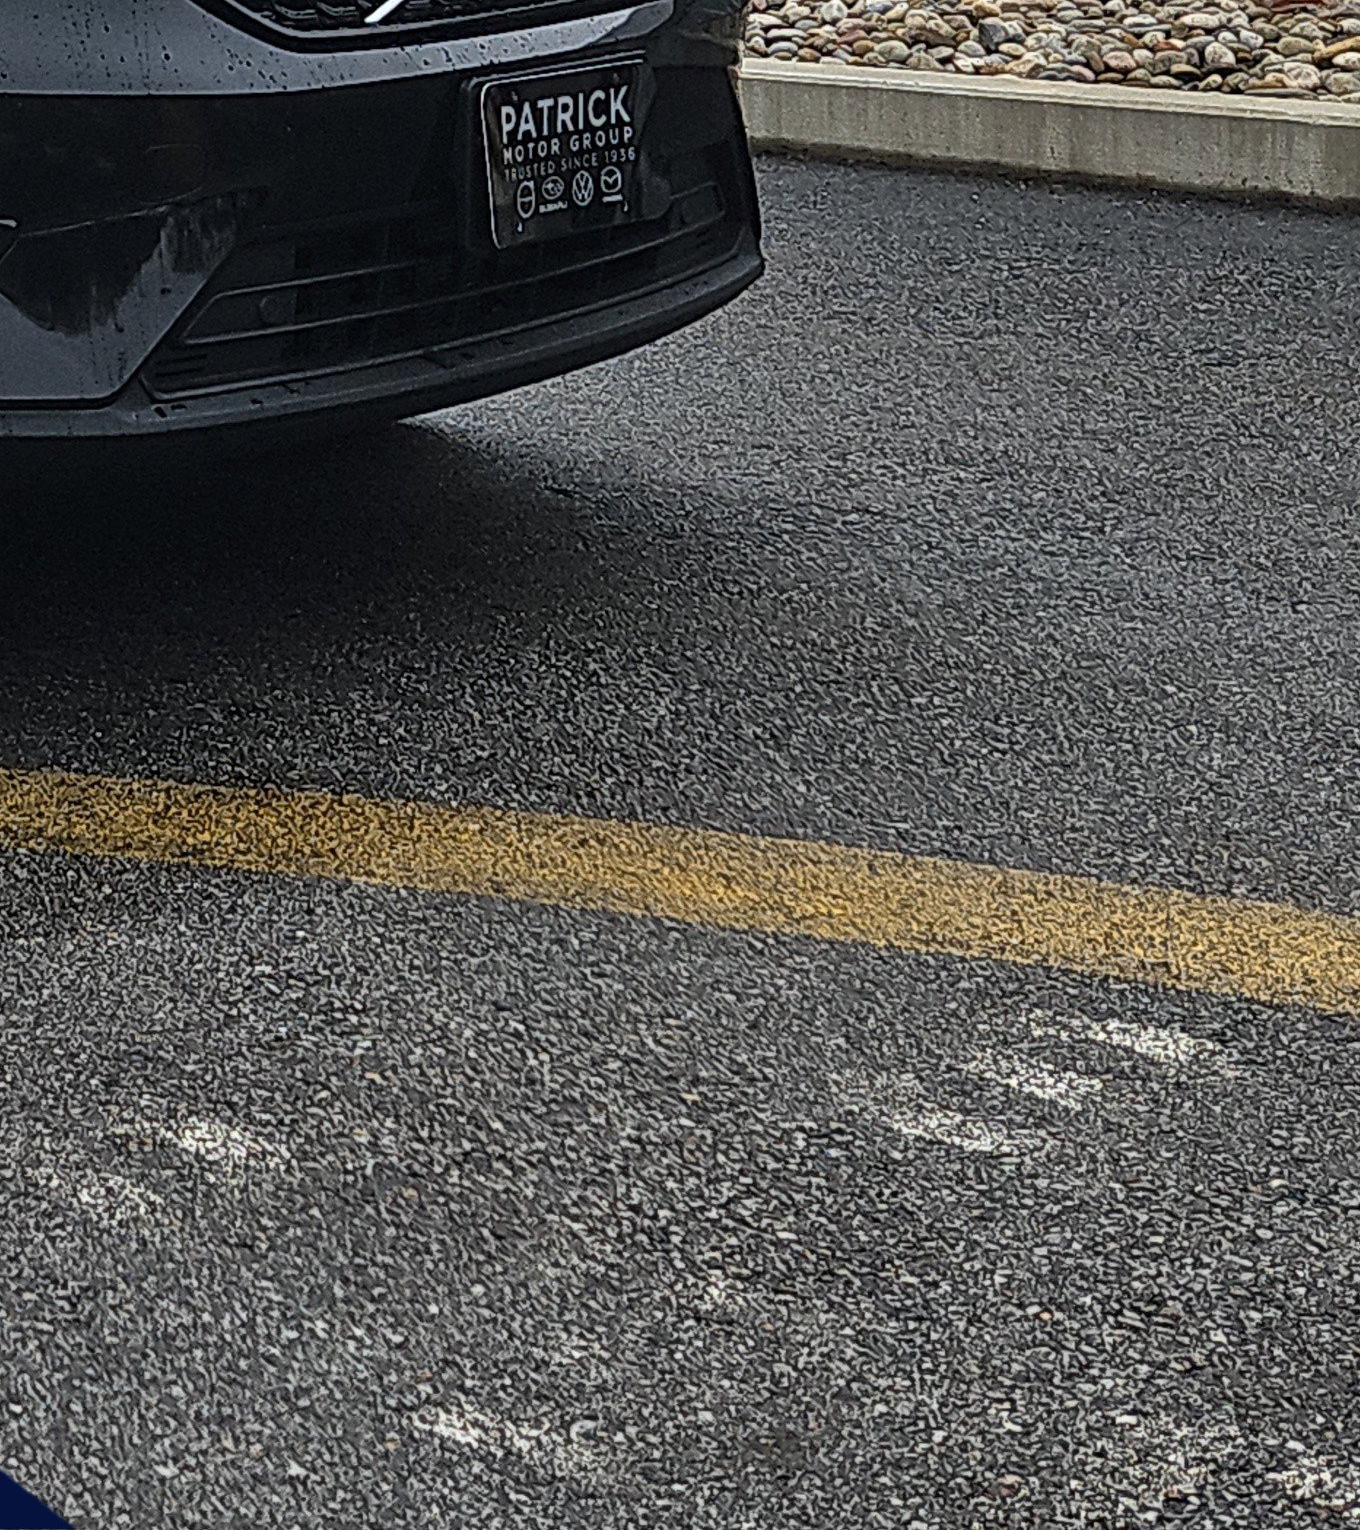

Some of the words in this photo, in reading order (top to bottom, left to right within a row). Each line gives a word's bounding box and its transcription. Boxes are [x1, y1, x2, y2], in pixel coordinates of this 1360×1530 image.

[501, 85, 631, 144] PATRICK
[502, 139, 561, 165] MOTOR
[569, 126, 634, 153] GROUP
[504, 159, 556, 183] TRUSTED
[560, 151, 599, 172] SINCE
